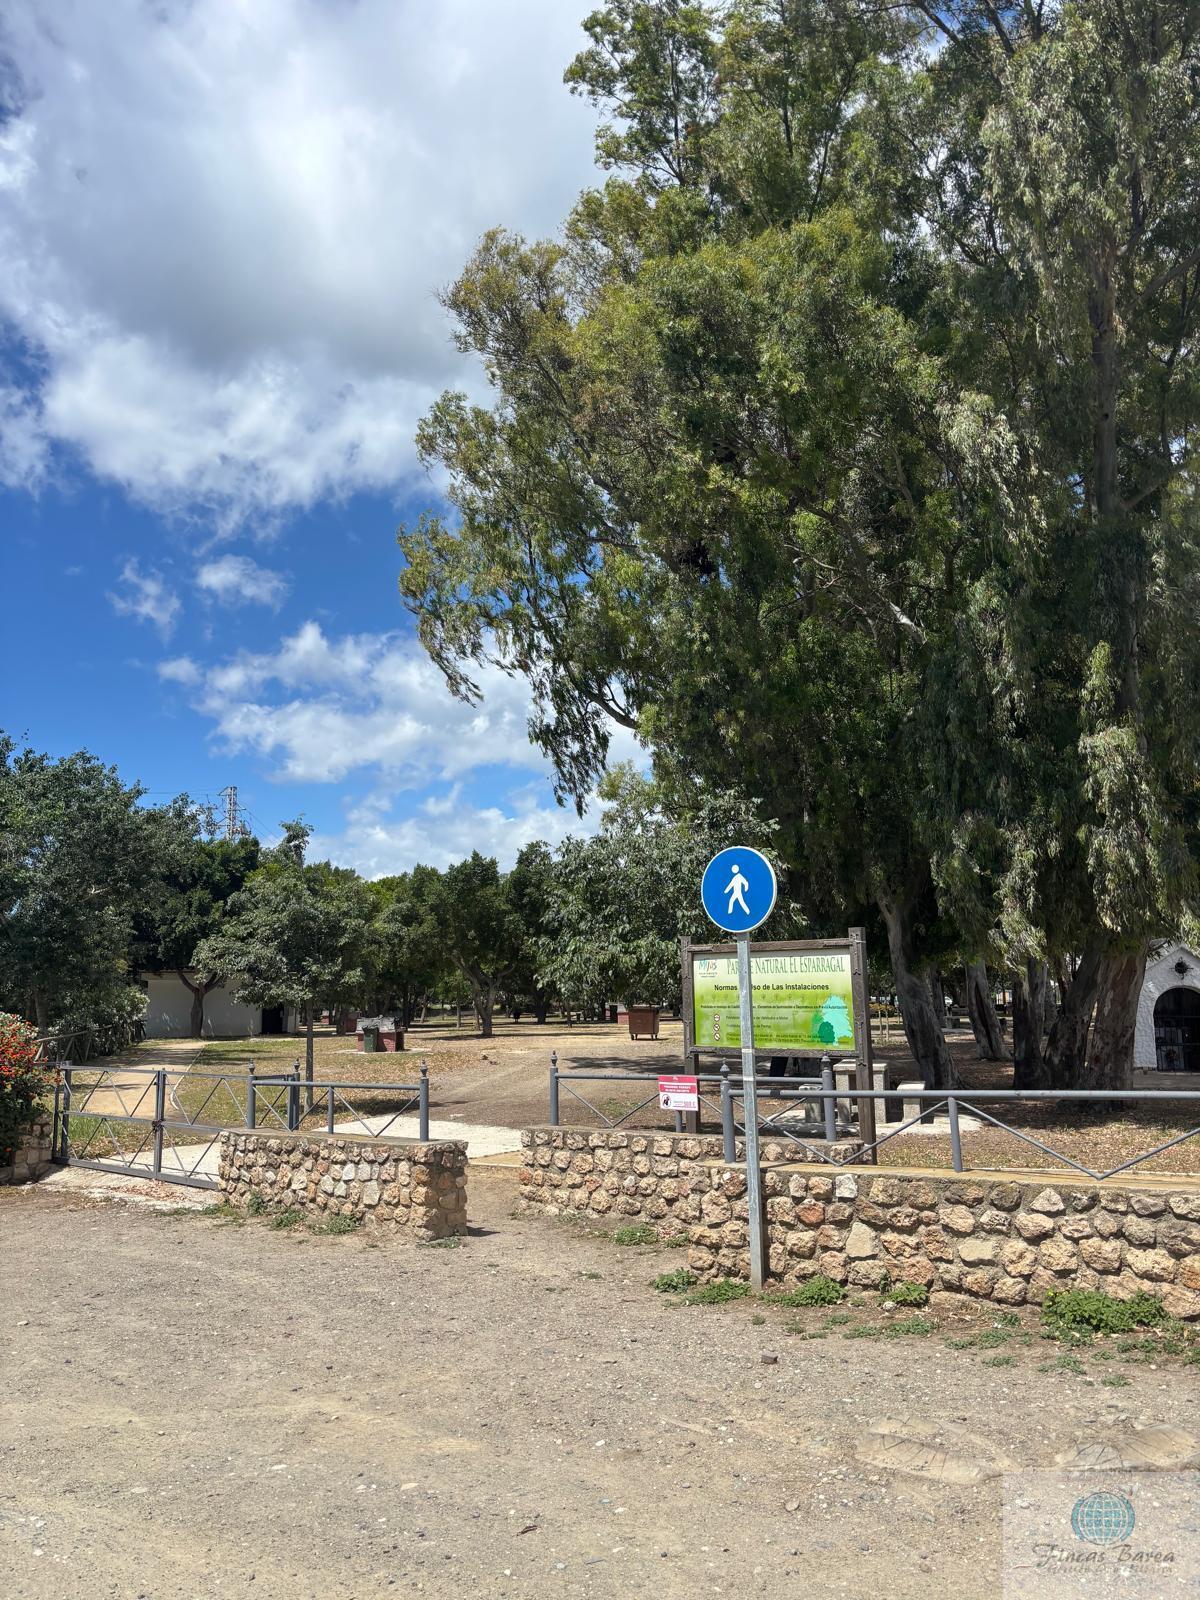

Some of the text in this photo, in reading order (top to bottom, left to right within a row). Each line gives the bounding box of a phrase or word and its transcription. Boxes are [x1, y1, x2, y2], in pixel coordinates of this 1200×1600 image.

[727, 958, 753, 975] PARE
[755, 957, 788, 974] NATURAL
[800, 956, 845, 973] ESPARRAGAL
[762, 983, 771, 991] de
[772, 983, 784, 991] Las
[785, 983, 829, 991] Instalaciones
